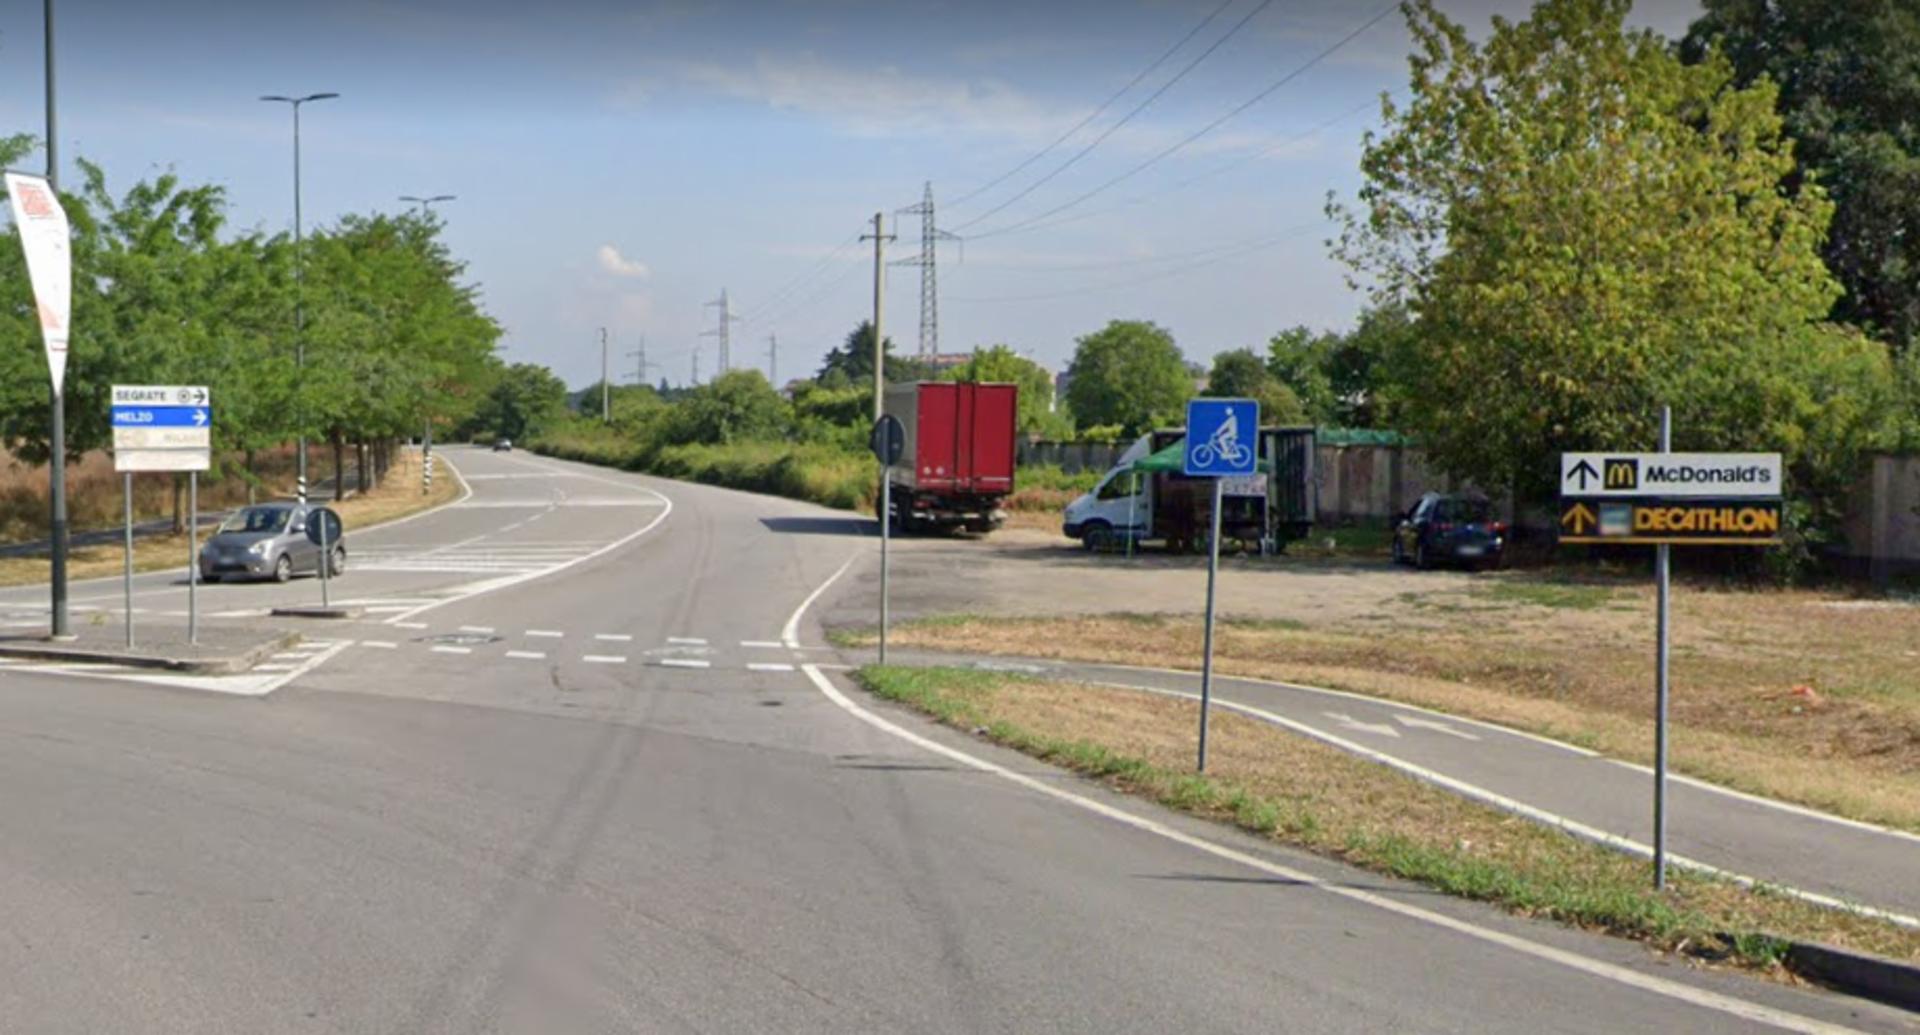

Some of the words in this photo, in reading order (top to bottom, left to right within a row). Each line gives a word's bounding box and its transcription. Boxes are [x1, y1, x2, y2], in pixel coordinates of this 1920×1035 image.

[116, 390, 166, 401] SEGRATE
[115, 411, 153, 423] MELZO
[1645, 466, 1772, 482] McDonald's
[1635, 508, 1778, 531] DECATHLON
